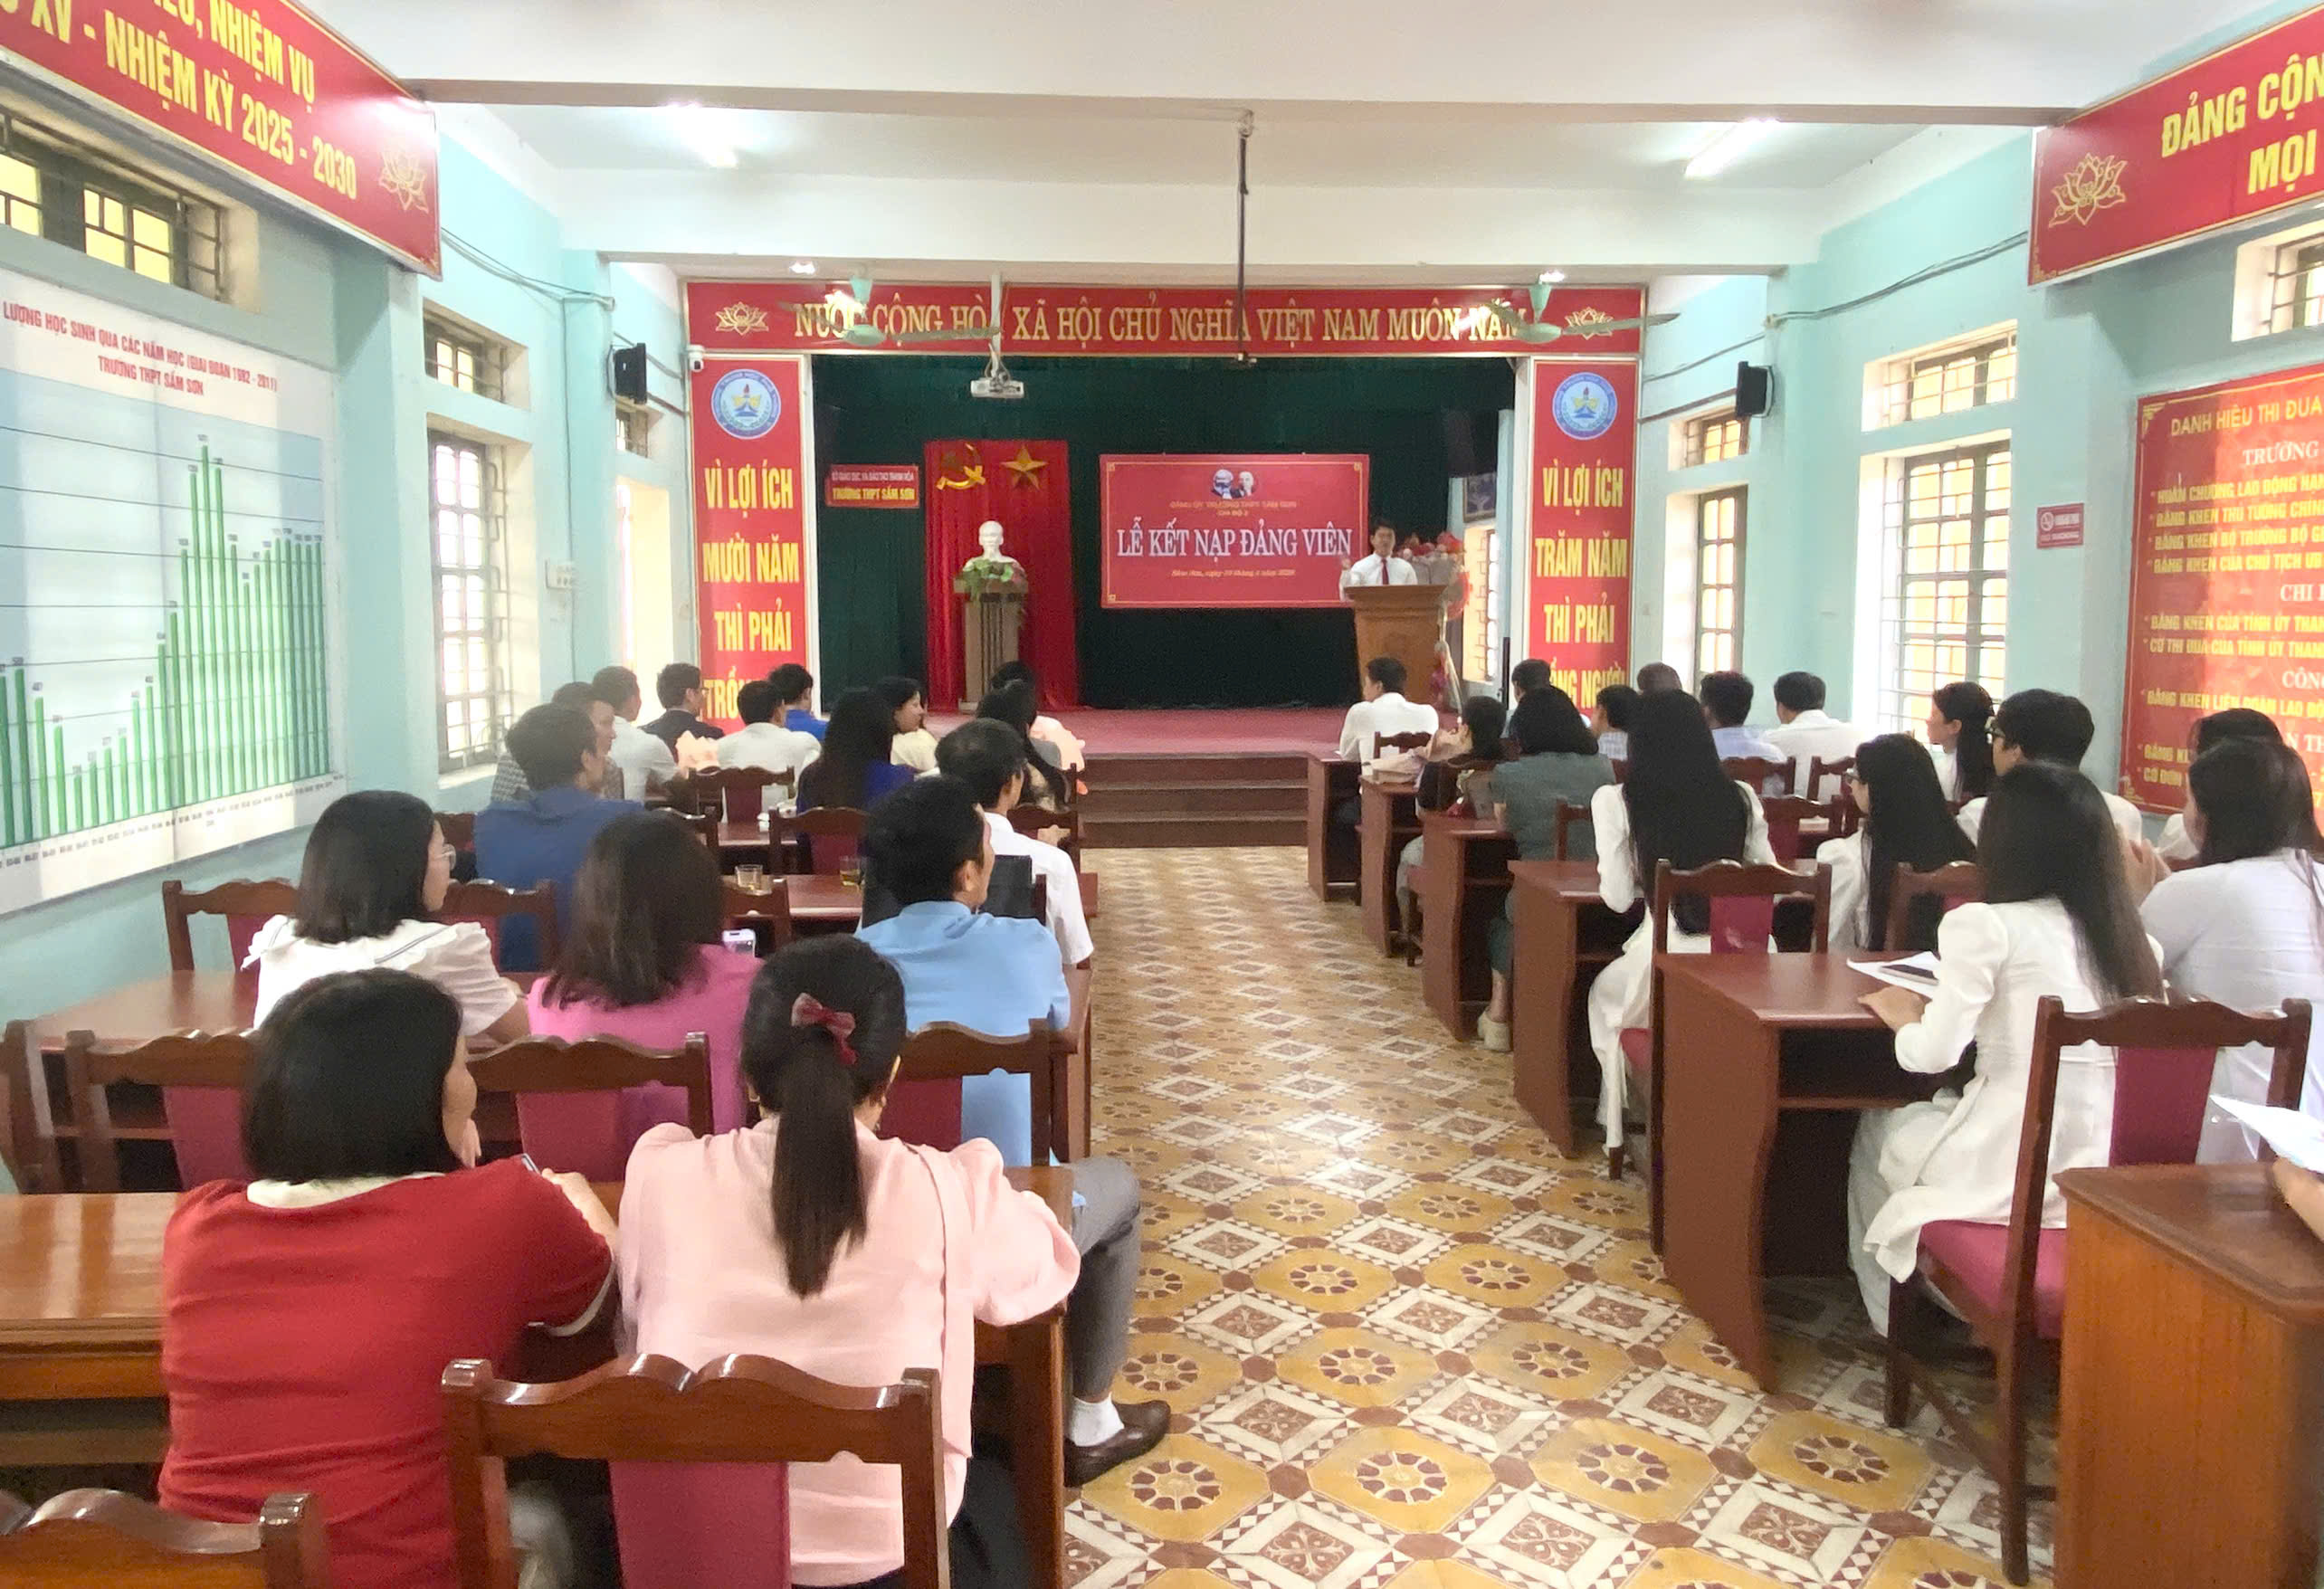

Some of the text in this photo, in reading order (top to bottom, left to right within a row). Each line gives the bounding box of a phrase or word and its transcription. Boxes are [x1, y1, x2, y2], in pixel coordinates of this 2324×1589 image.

[210, 0, 284, 85] NHIỆM
[288, 44, 316, 114] VỤ
[104, 9, 197, 112] NHIỆM
[204, 69, 234, 133] KỲ
[241, 93, 294, 166] 2025
[312, 137, 357, 200] 2030
[2161, 86, 2247, 158] ĐẢNG
[2248, 128, 2317, 194] MỌI
[45, 312, 67, 336] HỌC
[71, 319, 96, 342] SINH
[99, 328, 119, 349] QUA
[121, 334, 140, 355] CÁC
[143, 340, 165, 361] NĂM
[872, 291, 943, 347] CỘNG
[950, 293, 997, 332] HÒ
[1012, 299, 1050, 340] XÃ
[1057, 296, 1102, 349] HỘI
[1109, 290, 1161, 341] CHỦ
[1169, 300, 1252, 341] NGHĨA
[1256, 297, 1315, 348] VIỆT
[1322, 308, 1381, 341] NAM
[1386, 297, 1462, 341] MUÔN
[139, 366, 161, 385] THPT
[2171, 395, 2322, 436] DANH HIỆU THI ĐUA
[2243, 440, 2319, 466] TRƯỜNG
[704, 458, 794, 519] VÌ LỢI ÍCH
[1542, 459, 1624, 516] VÌ LỢI ÍCH
[702, 532, 800, 582] MƯỜI NĂM
[1118, 517, 1353, 563] LỄ KẾT NẠP ĐẢNG VIÊN
[1535, 530, 1627, 577] TRĂM NĂM
[1544, 593, 1615, 642] THÌ PHẢI
[2281, 584, 2314, 602] CHI
[714, 597, 792, 652] THÌ PHẢI
[703, 665, 752, 718] TRỒ
